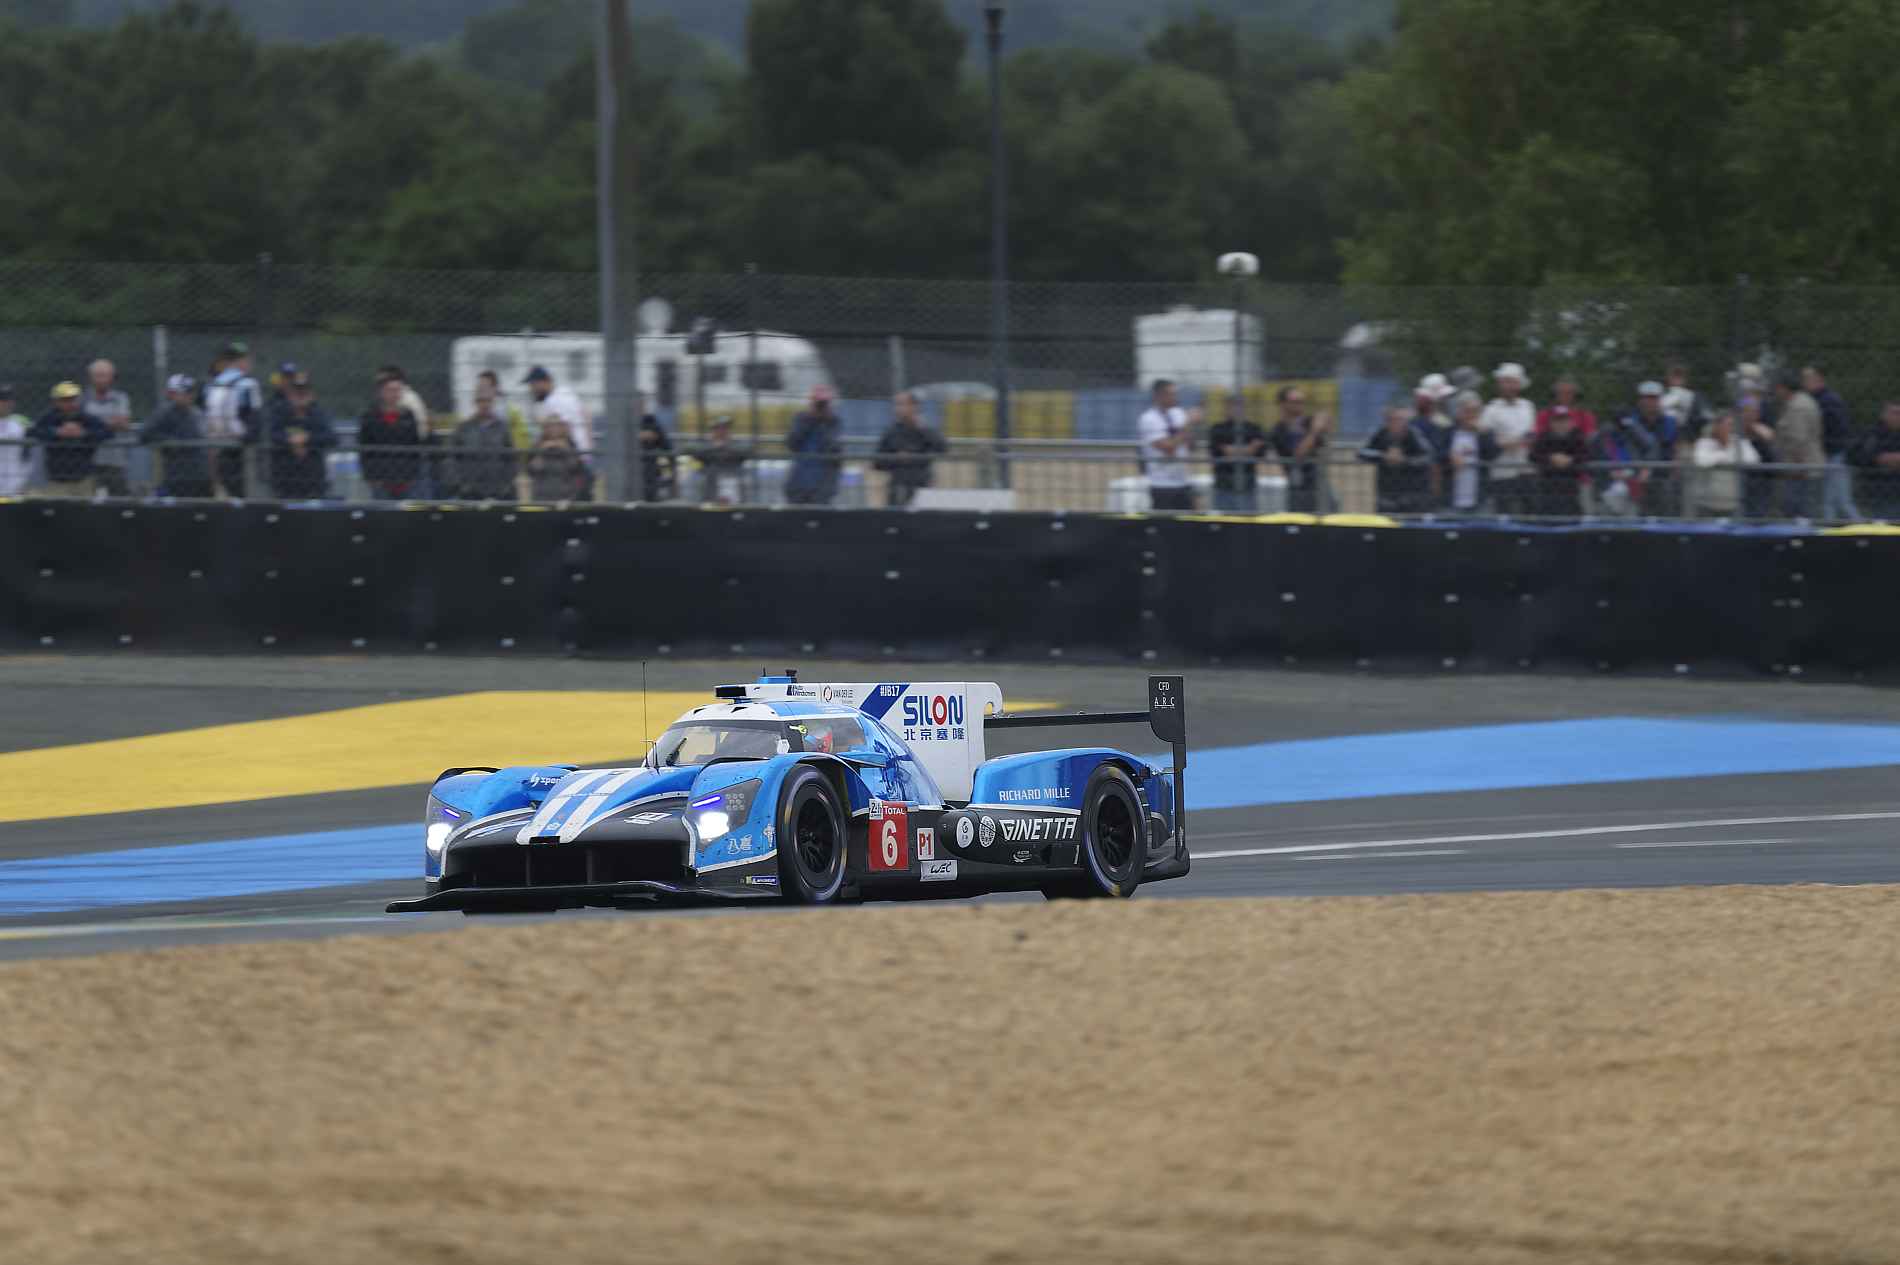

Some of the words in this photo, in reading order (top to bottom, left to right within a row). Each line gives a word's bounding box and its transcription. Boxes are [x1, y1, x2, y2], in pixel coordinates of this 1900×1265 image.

[903, 695, 964, 726] SILON
[999, 788, 1041, 802] RICHARD
[1043, 787, 1071, 799] MILLE
[883, 805, 905, 815] TOTAL
[998, 817, 1078, 841] GINETTA
[881, 819, 898, 867] 6
[918, 831, 932, 856] P1
[930, 862, 952, 874] WEC
